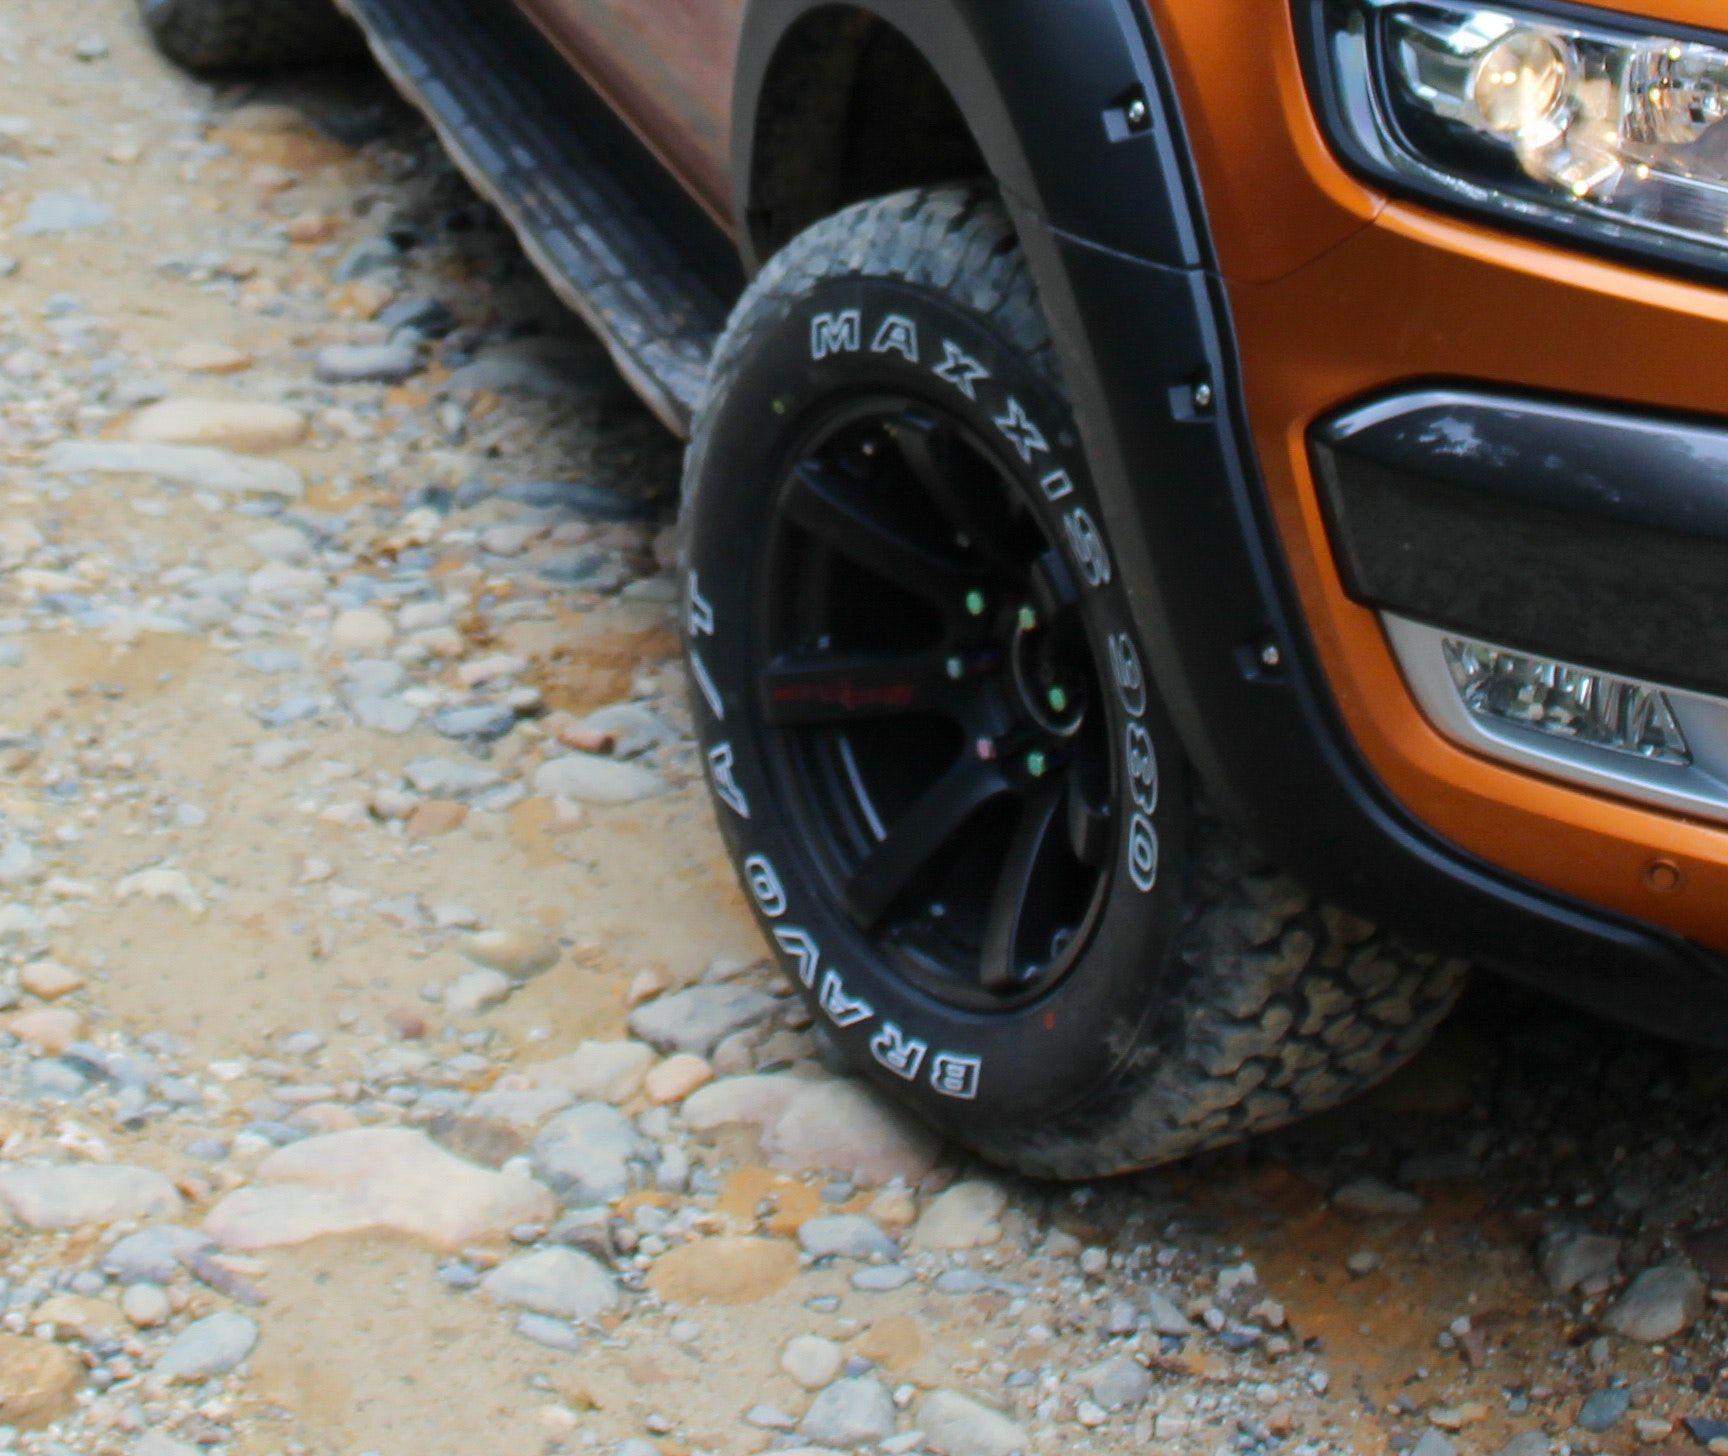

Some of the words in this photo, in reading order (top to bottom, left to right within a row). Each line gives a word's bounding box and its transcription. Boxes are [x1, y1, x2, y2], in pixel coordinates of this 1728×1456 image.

[810, 309, 1112, 588] MAXXIS
[1108, 631, 1160, 893] 980
[745, 853, 982, 1101] BRAVO
